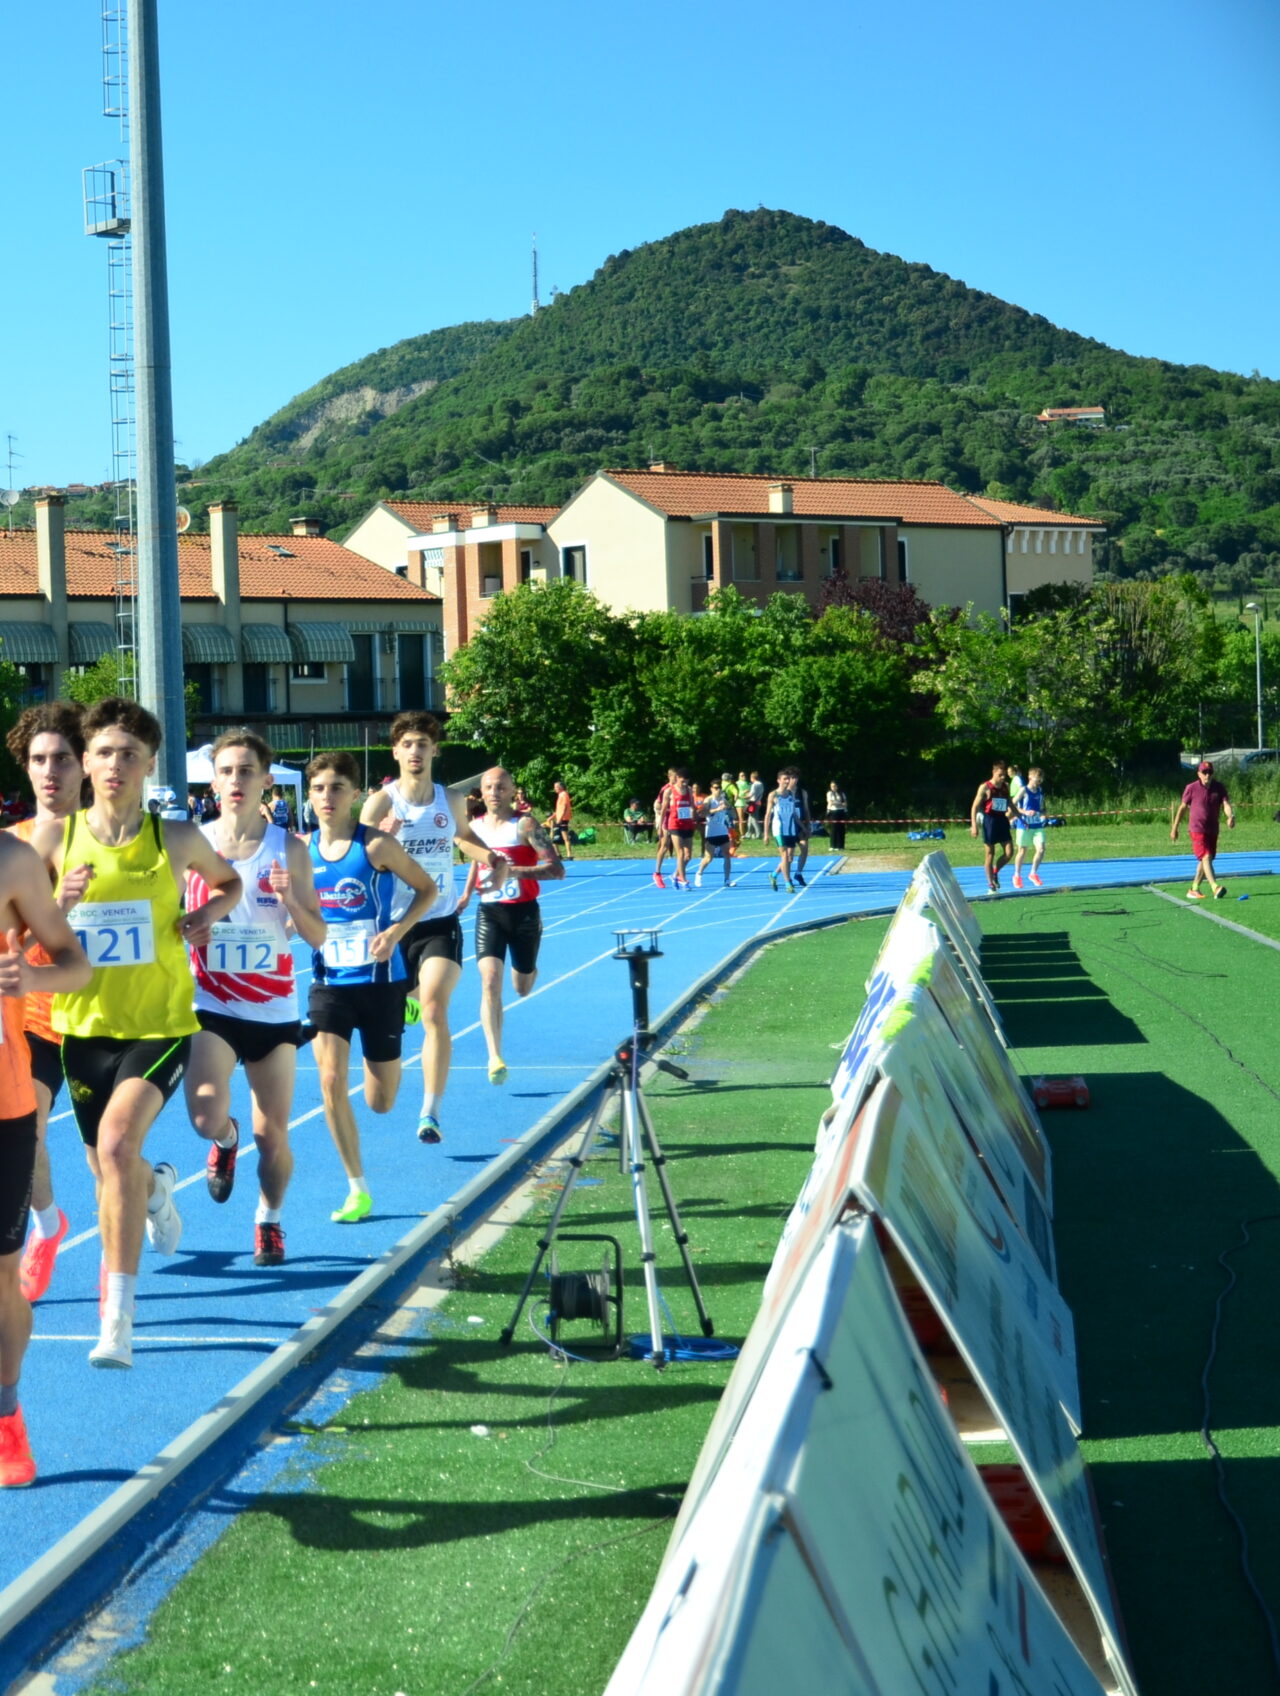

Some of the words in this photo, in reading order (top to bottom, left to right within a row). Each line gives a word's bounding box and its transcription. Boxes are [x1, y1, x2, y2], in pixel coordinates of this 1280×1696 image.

[403, 838, 436, 847] TEAM
[102, 907, 137, 917] VENETA
[76, 926, 141, 963] 121
[215, 943, 272, 970] 112
